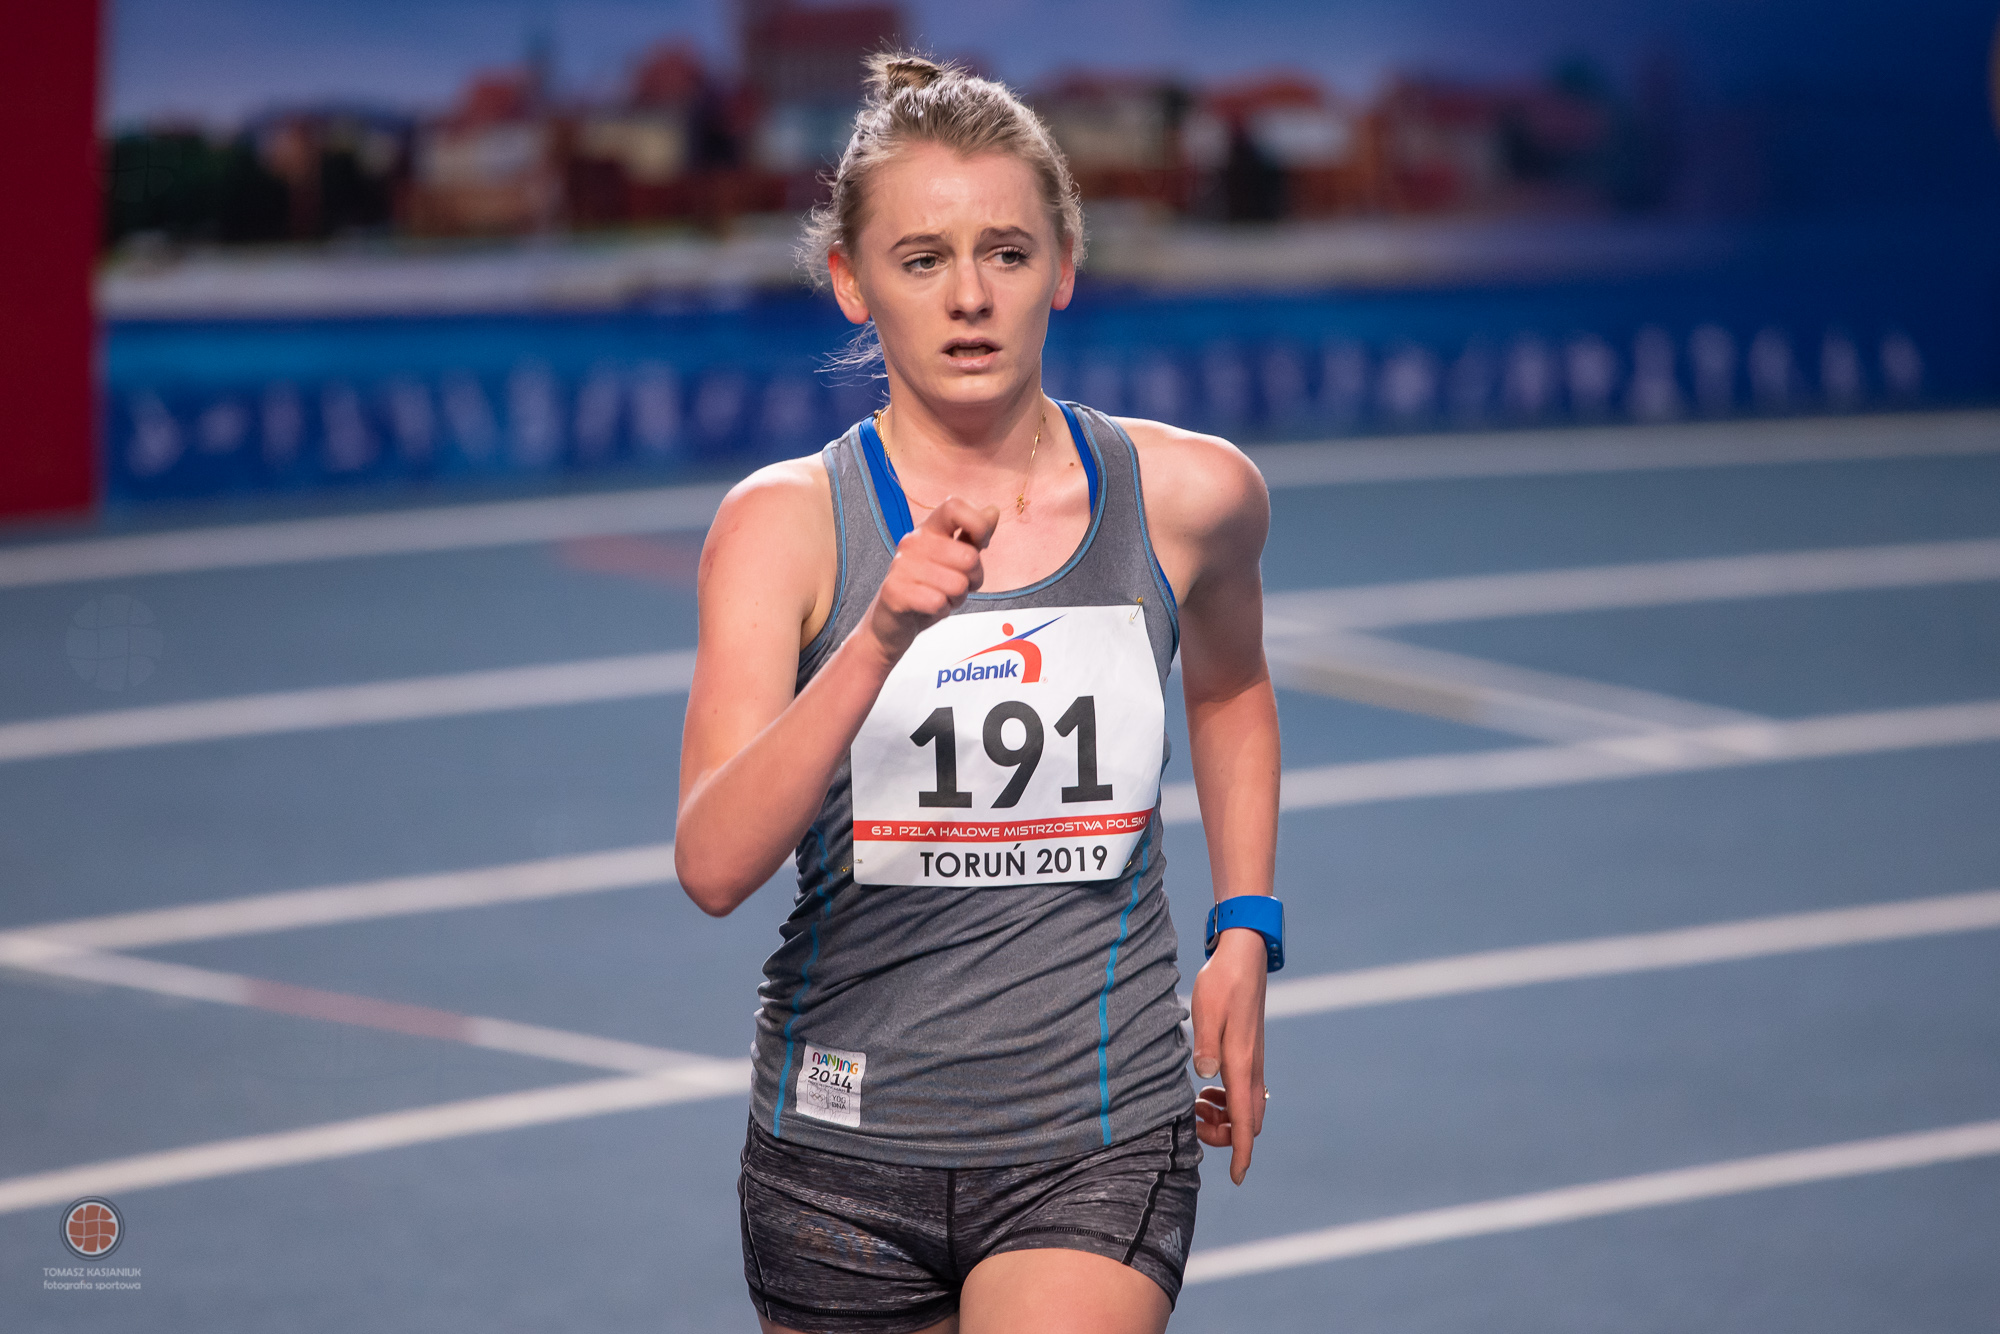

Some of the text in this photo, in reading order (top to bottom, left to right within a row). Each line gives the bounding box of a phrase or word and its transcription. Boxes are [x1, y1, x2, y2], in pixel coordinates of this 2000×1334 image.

[936, 658, 1019, 689] polanik
[909, 695, 1113, 809] 191
[871, 815, 1146, 838] 63. PZLA HALOWE MISTRZOSTWA POLSKI
[920, 843, 1108, 878] TORUŃ 2019
[808, 1067, 852, 1093] 2014
